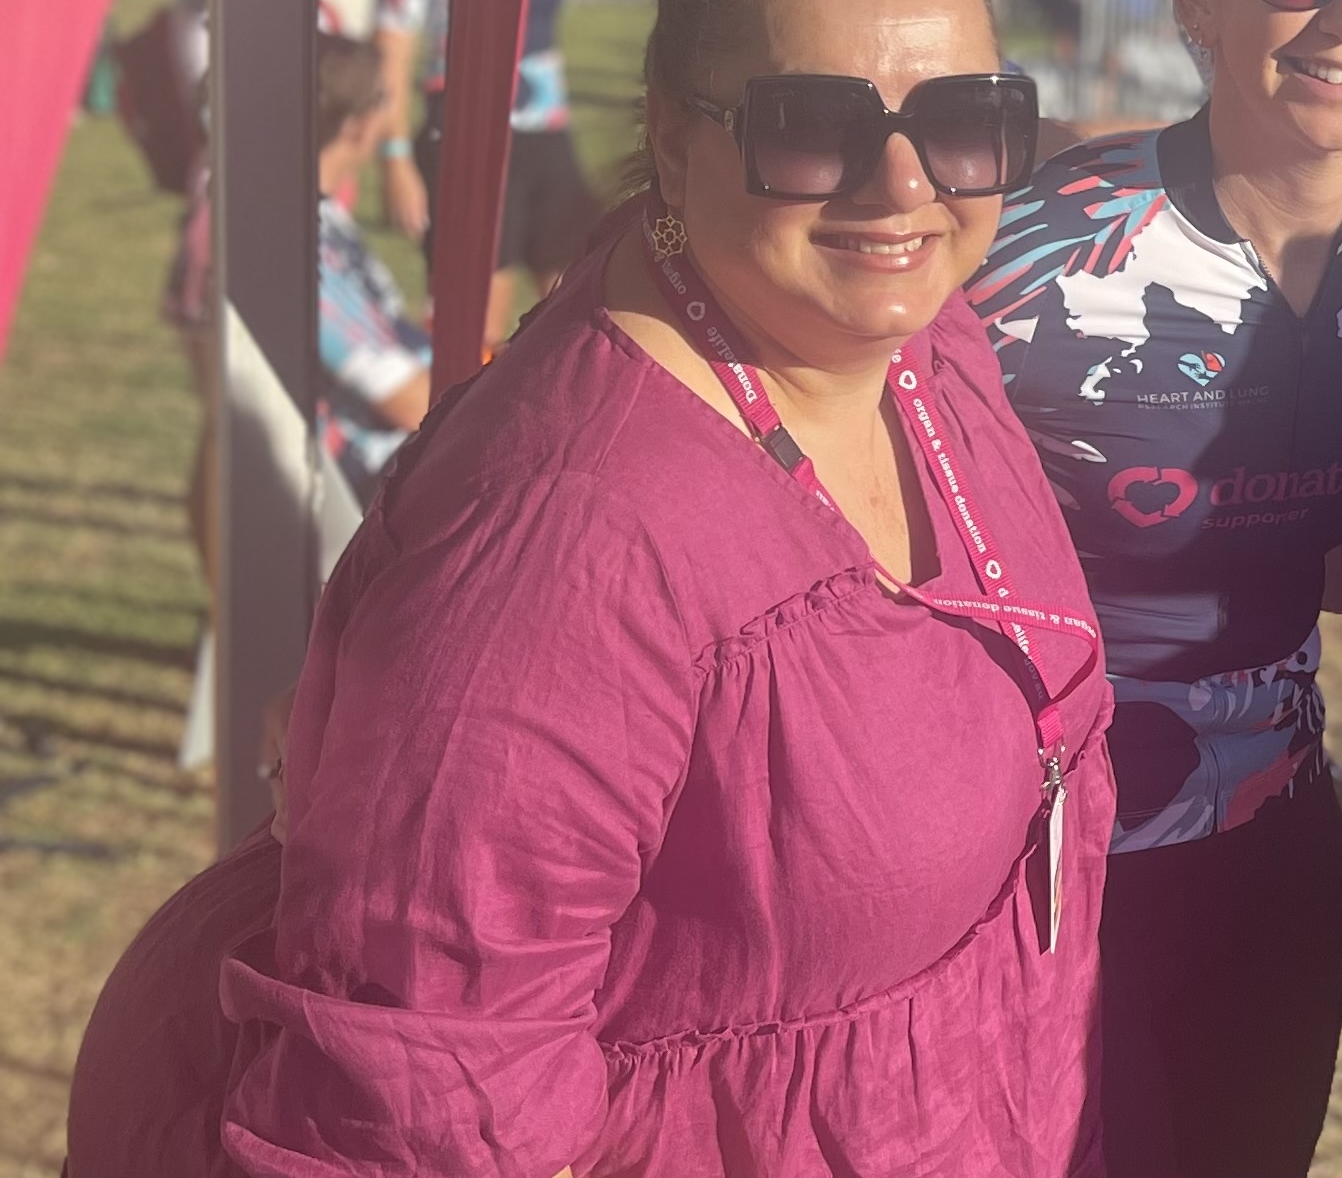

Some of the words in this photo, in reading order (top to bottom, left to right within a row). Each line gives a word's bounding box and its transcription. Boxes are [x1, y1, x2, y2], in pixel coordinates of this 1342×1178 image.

[1137, 391, 1189, 405] HEART
[1192, 389, 1226, 402] AND
[1230, 385, 1270, 399] LUNG
[912, 398, 936, 438] organ
[931, 438, 942, 452] &
[937, 452, 959, 493] tissue
[954, 495, 987, 554] donation
[934, 598, 1000, 612] donation
[1003, 605, 1046, 621] tissue
